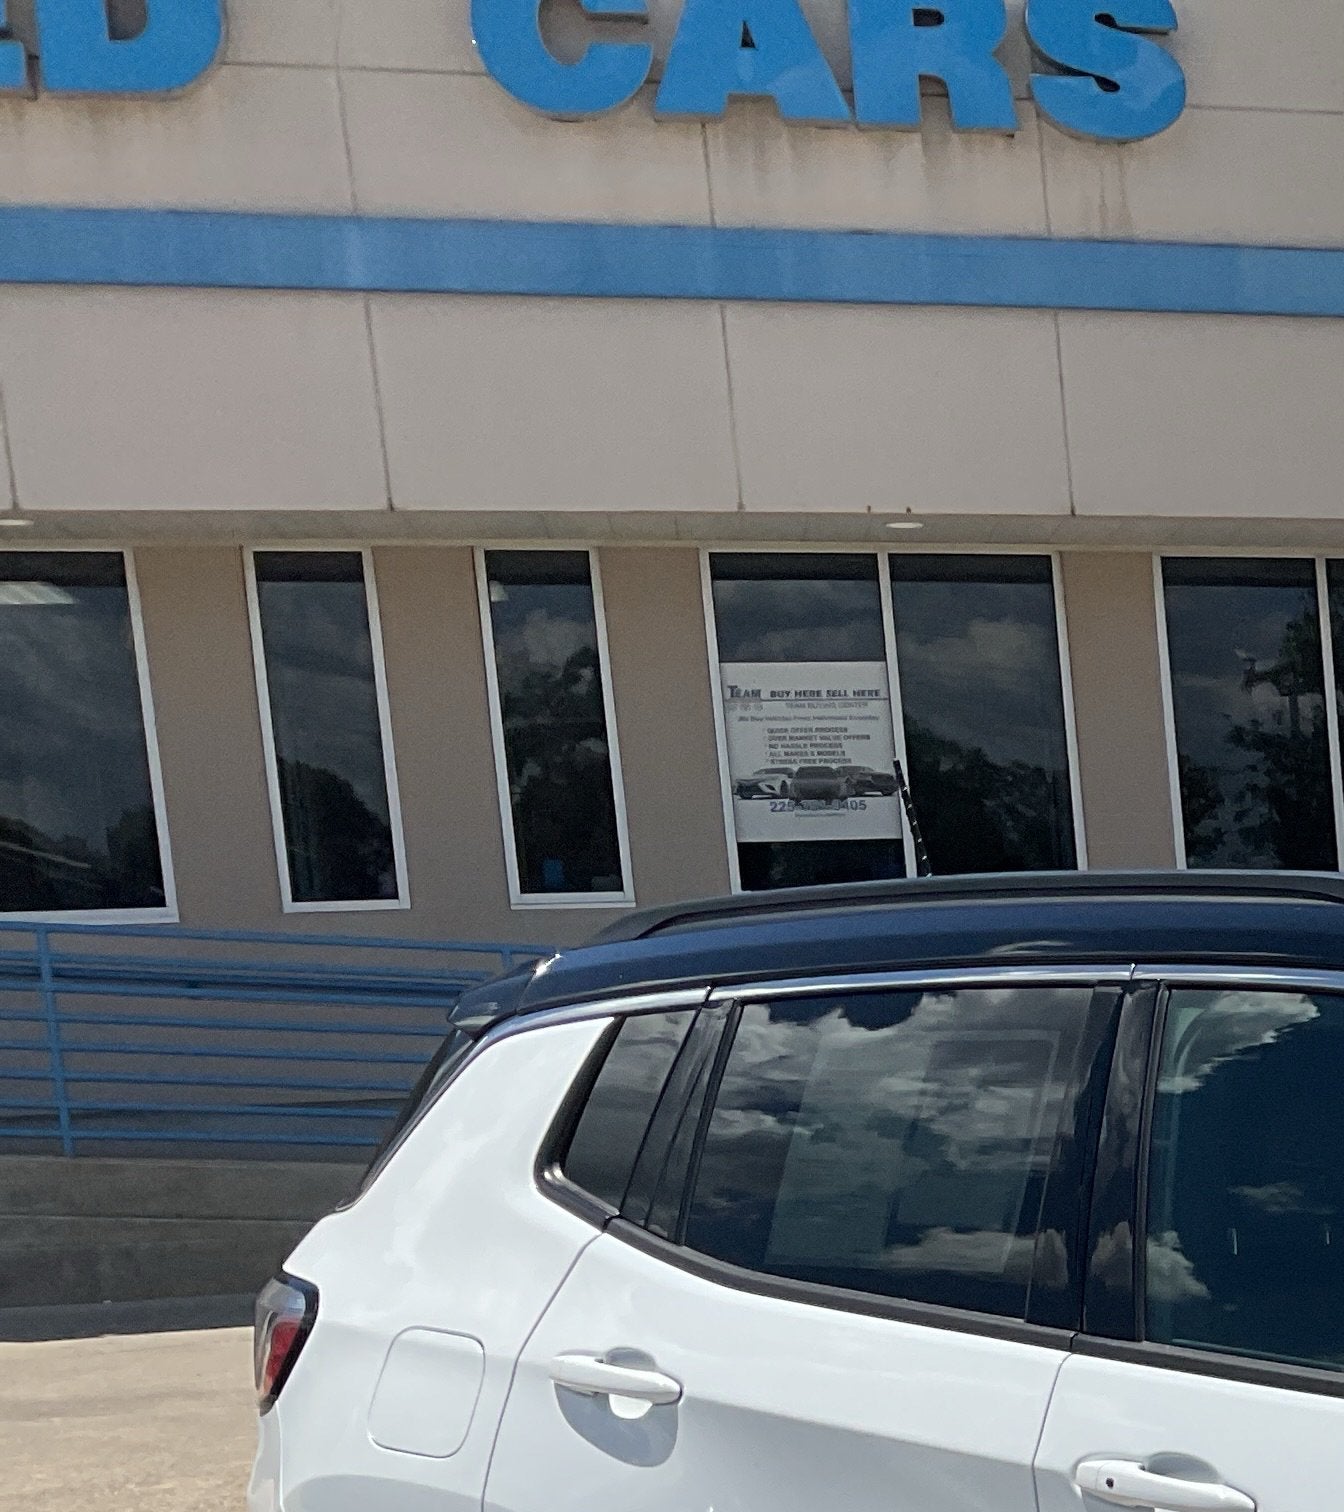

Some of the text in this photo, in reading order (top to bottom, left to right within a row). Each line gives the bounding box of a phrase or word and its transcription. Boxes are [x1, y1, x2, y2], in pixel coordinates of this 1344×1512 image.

[470, 0, 1188, 143] CARS
[770, 689, 881, 698] BUY HERE SELL HERE
